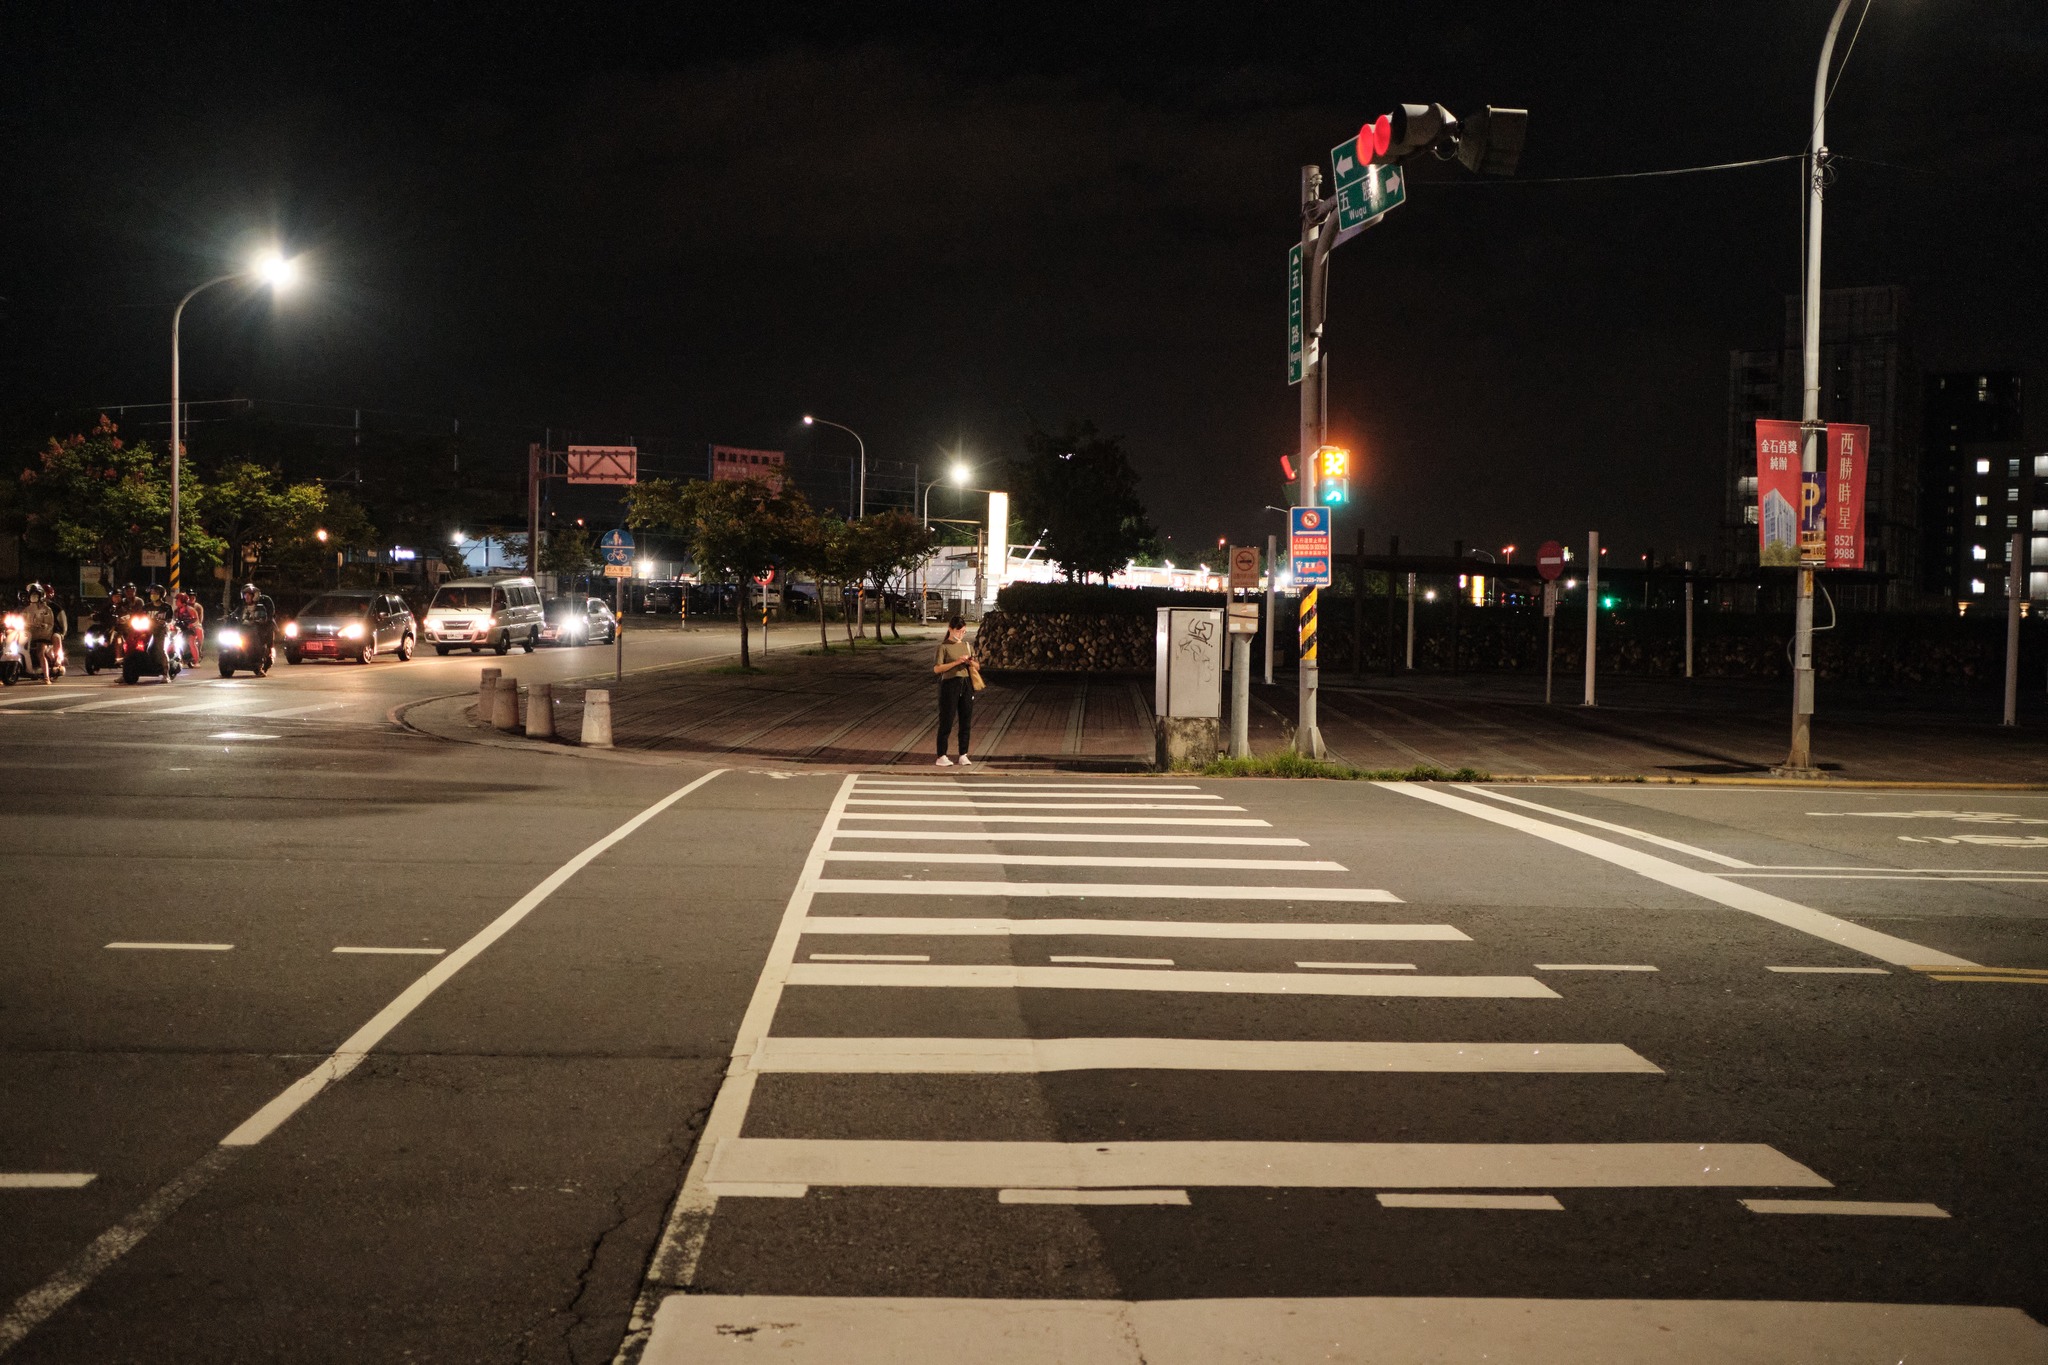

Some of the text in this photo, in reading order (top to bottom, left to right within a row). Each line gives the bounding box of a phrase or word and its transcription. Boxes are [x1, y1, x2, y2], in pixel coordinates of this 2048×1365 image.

[1348, 206, 1367, 221] Wugu
[1760, 439, 1798, 454] 金石首獎
[1838, 433, 1854, 529] 西勝時星
[1802, 482, 1821, 520] P
[1834, 535, 1853, 546] 8521
[1834, 548, 1855, 559] 9988
